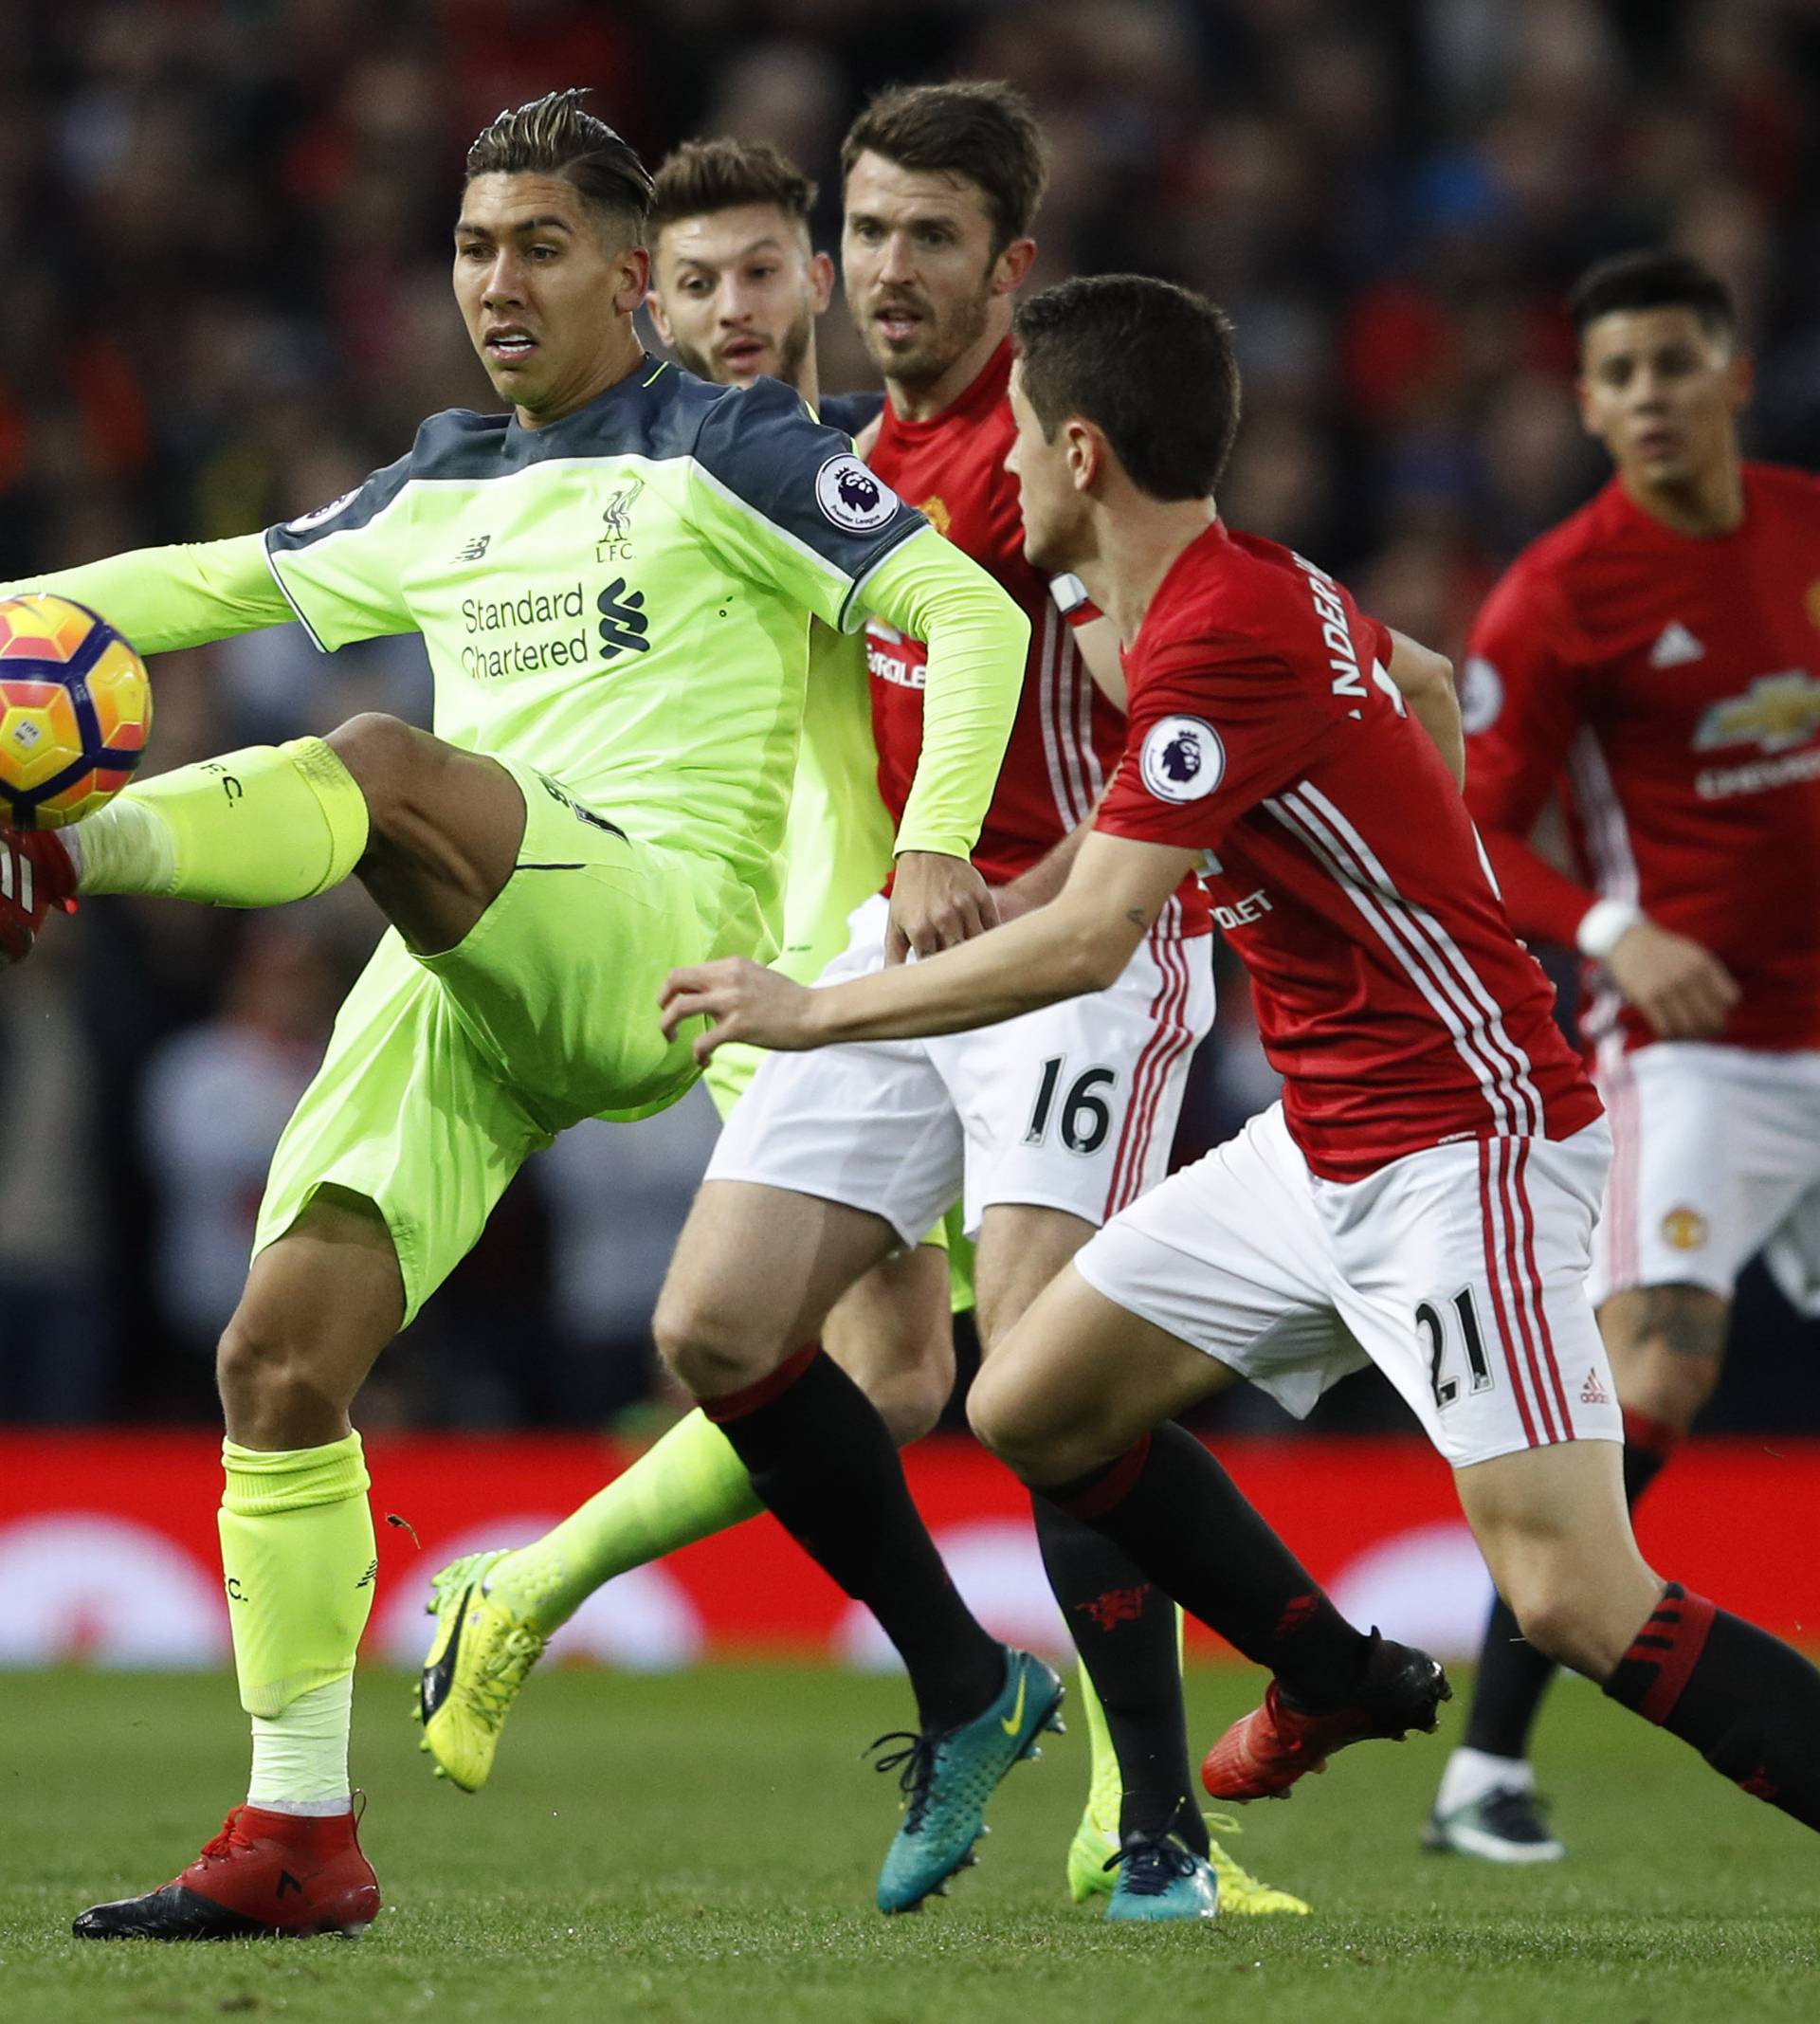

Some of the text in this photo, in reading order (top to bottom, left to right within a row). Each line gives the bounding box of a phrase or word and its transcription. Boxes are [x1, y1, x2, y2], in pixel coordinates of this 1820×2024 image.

[462, 582, 584, 634] Standard
[461, 629, 589, 680] Chartered
[1208, 888, 1274, 930] OLET
[1021, 1054, 1118, 1156] 16
[1414, 1283, 1495, 1410] 21
